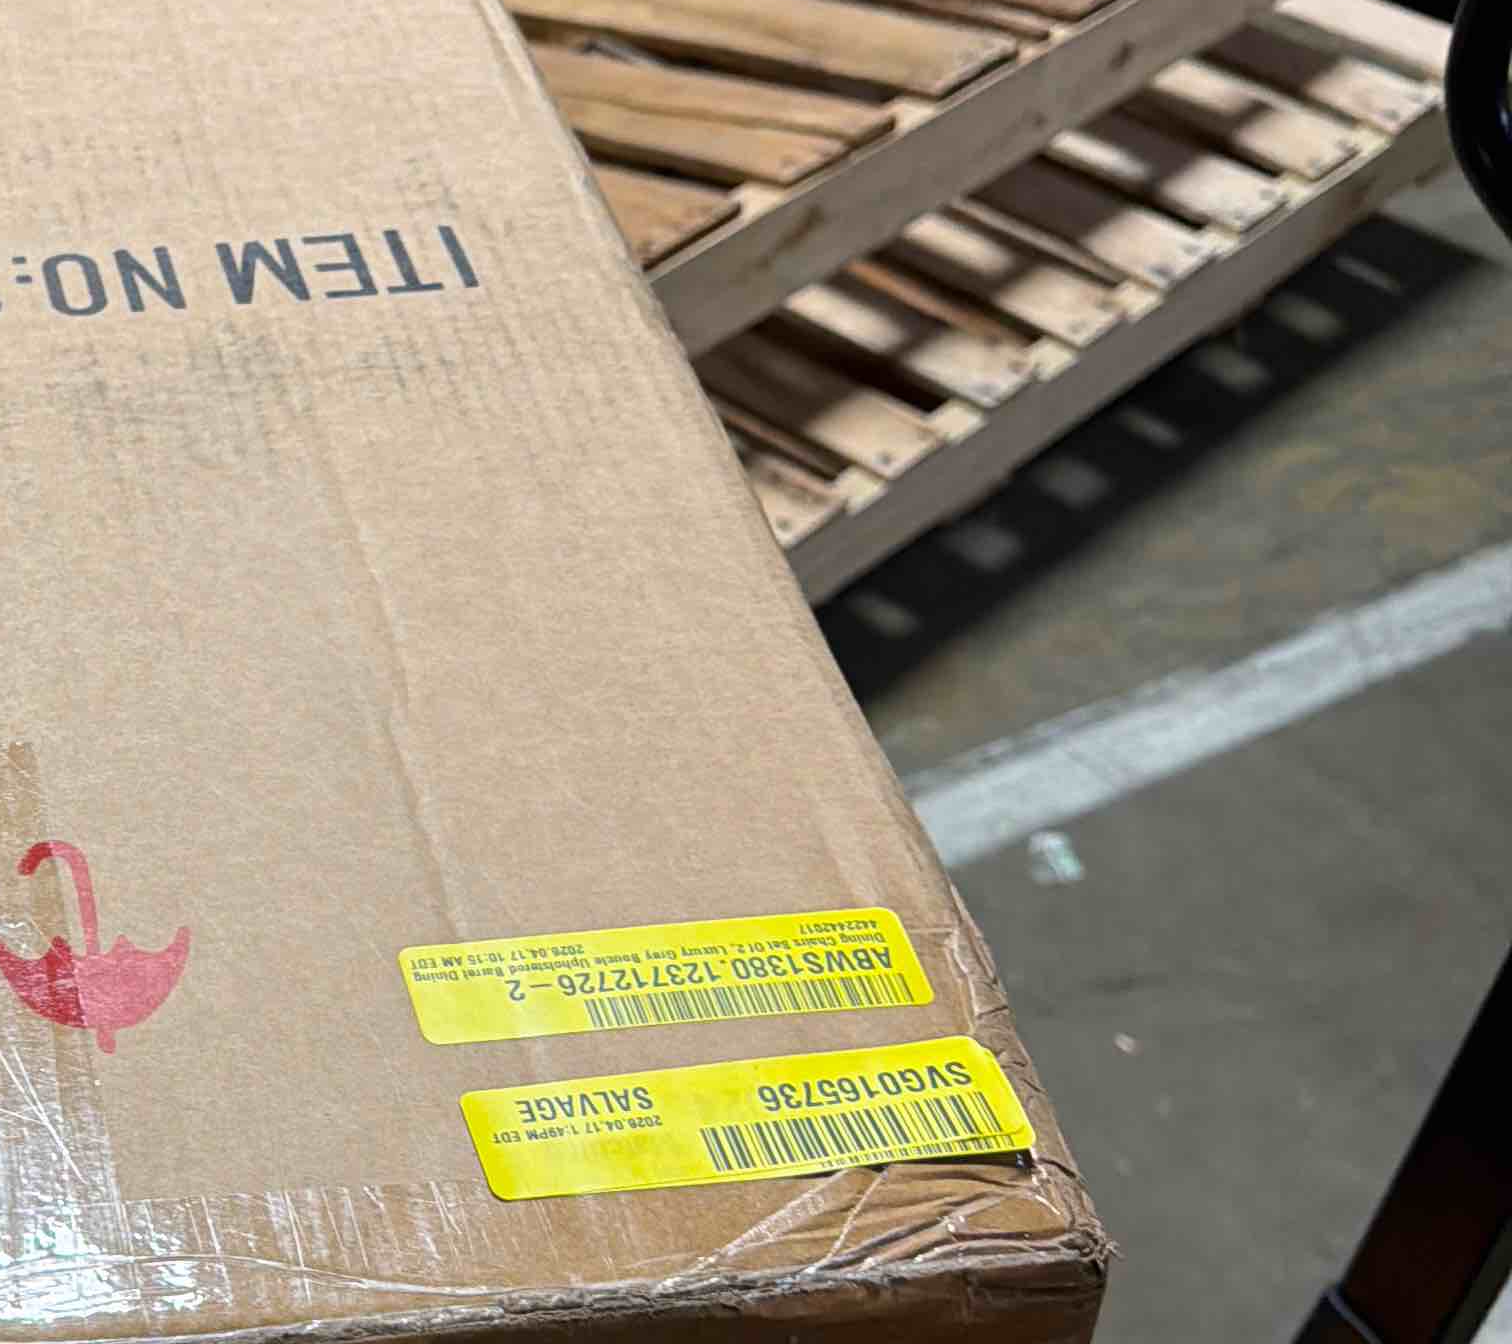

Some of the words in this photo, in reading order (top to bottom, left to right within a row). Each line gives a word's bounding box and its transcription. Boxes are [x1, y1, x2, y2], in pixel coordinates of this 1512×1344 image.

[214, 224, 479, 307] ITEM
[793, 936, 836, 950] Chairs
[409, 958, 437, 970] EDT
[441, 956, 462, 968] AM
[510, 956, 590, 975] Upholstered
[413, 969, 458, 983] Dining
[757, 1060, 972, 1112] SVG0165736
[514, 1086, 654, 1124] SALVAGE
[492, 1130, 520, 1144] EDT
